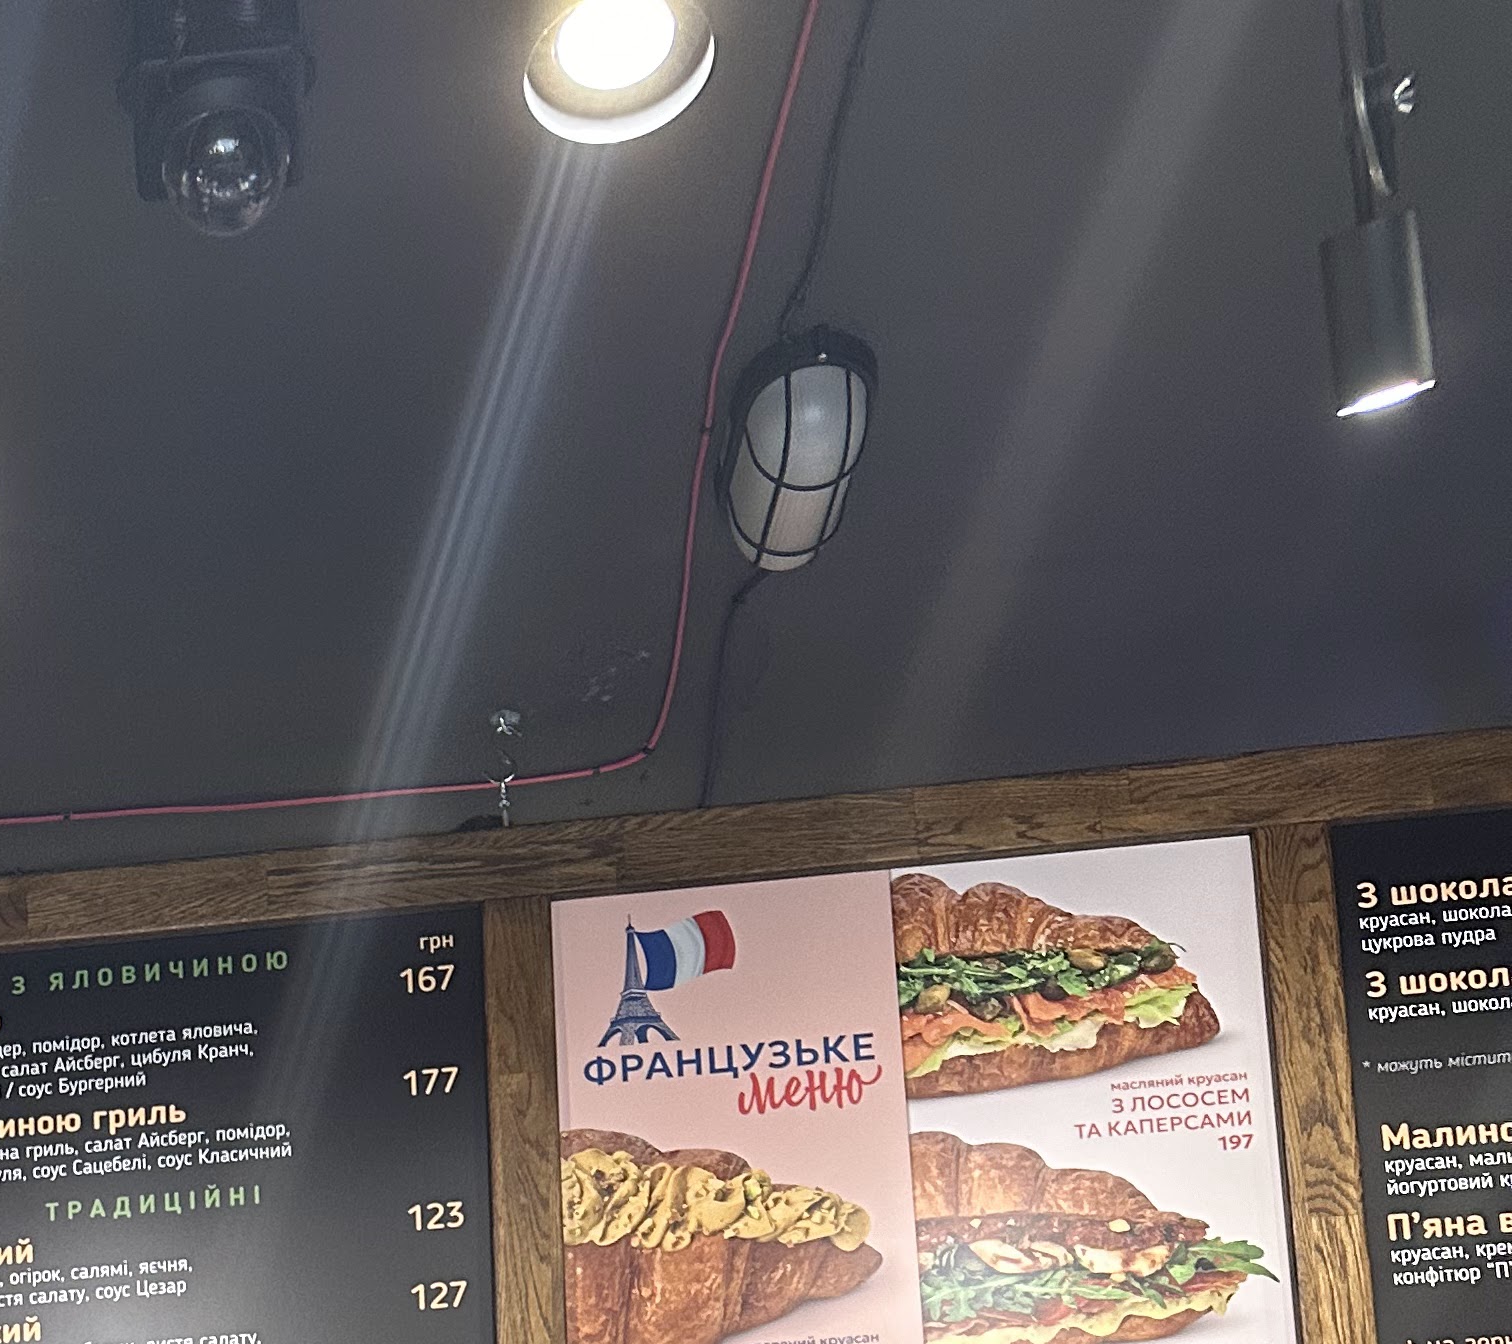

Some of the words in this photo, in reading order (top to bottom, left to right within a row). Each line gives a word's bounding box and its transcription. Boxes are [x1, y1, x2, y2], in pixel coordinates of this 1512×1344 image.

[420, 935, 453, 953] грн
[1362, 934, 1435, 954] цукрова
[1442, 929, 1496, 947] пудра
[11, 975, 26, 995] З
[50, 951, 287, 991] ЯЛОВИЧИНОЮ
[400, 965, 454, 993] 167
[583, 1032, 876, 1086] ФРАНЦУЗЬКЕ
[1110, 1082, 1184, 1095] масляний
[1188, 1073, 1248, 1090] круасан
[1110, 1081, 1130, 1114] З
[1133, 1086, 1251, 1112] ЛОСОСЕМ
[1073, 1123, 1102, 1140] ТА
[1107, 1110, 1252, 1137] КАПЕРСАМИ
[1217, 1133, 1254, 1151] 197
[45, 1184, 259, 1221] ТРАДИЦІЙНІ
[408, 1202, 464, 1230] 123
[411, 1281, 466, 1310] 127
